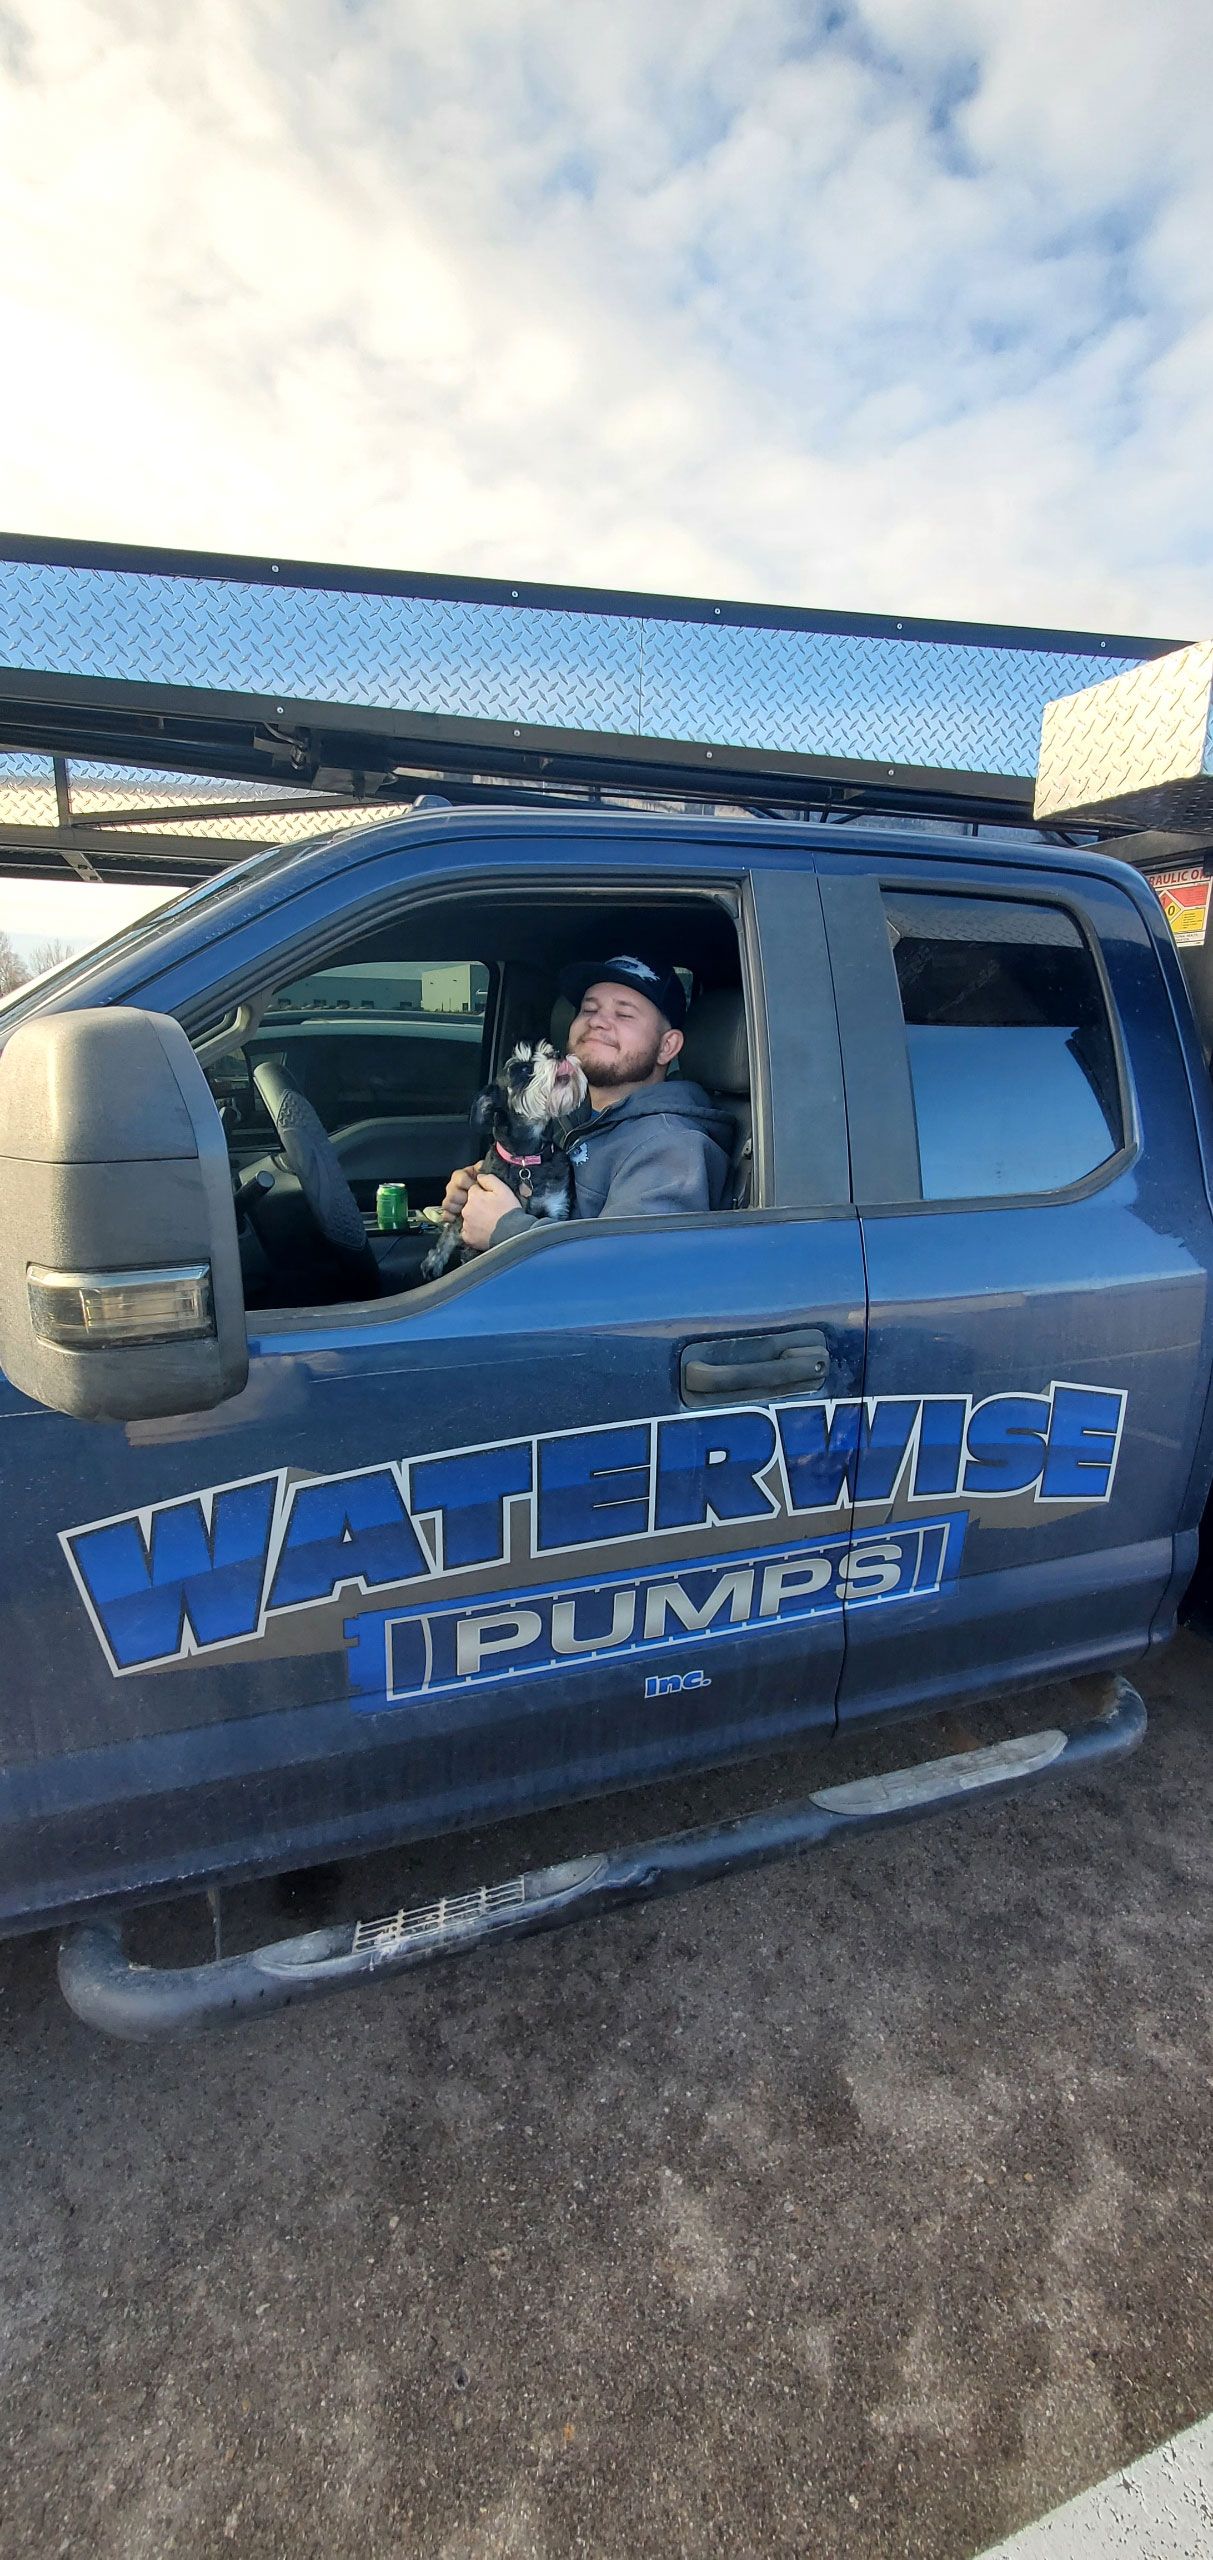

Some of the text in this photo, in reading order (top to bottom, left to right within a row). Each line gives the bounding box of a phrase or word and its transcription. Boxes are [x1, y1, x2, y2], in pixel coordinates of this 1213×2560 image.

[58, 1381, 1128, 1677] WATERWISE
[457, 1544, 902, 1675] PUMPS
[644, 1670, 712, 1698] Inc.
